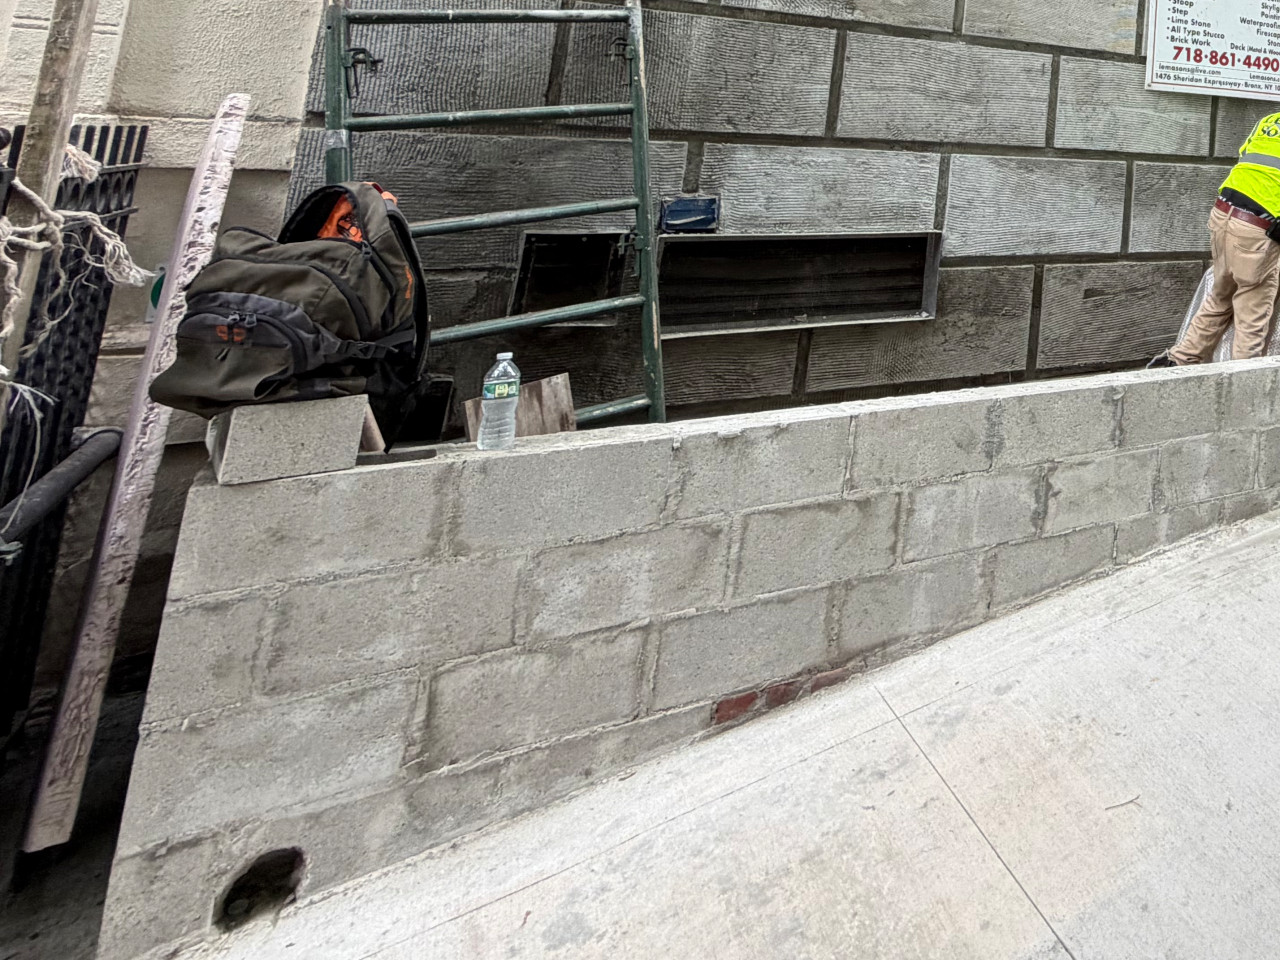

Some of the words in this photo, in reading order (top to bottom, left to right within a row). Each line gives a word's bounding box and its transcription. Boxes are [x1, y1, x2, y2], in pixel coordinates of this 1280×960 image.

[1172, 7, 1189, 16] Step
[1171, 16, 1188, 24] Lime
[1190, 19, 1211, 28] Stone
[1183, 27, 1200, 36] Type
[1203, 30, 1225, 39] Stucco
[1170, 35, 1188, 44] Brick
[1191, 38, 1211, 47] Work
[1230, 42, 1245, 51] Deck
[1158, 63, 1221, 75] lemasons@live.com
[1155, 72, 1171, 80] 1476
[1173, 74, 1202, 83] Sheridan
[1244, 82, 1263, 90] Bronx,
